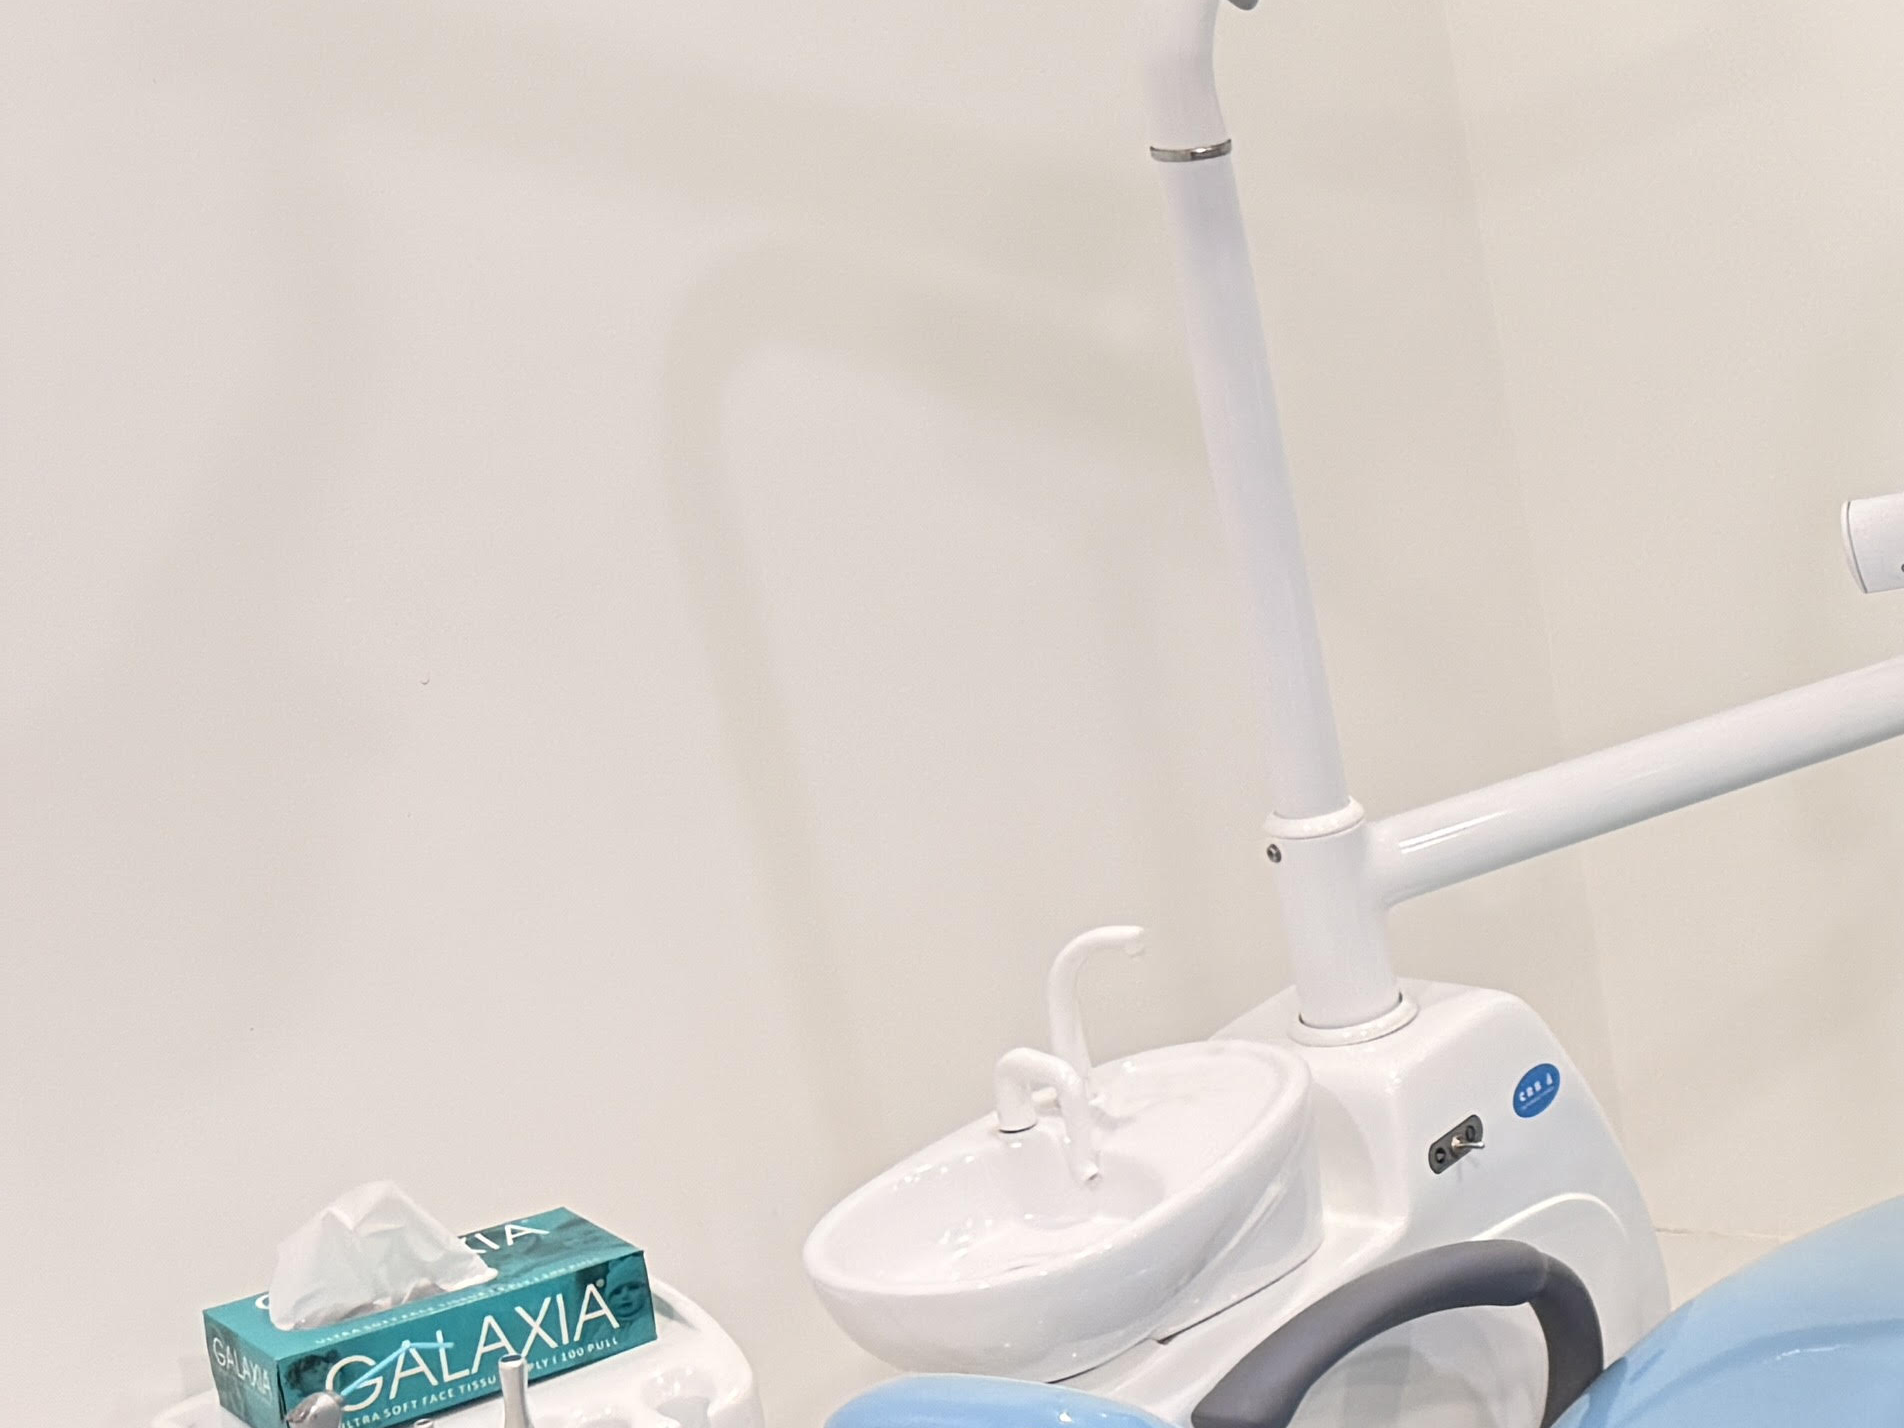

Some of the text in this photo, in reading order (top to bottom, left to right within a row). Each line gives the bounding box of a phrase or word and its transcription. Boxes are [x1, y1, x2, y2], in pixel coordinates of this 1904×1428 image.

[325, 1283, 620, 1412] GALAXIA
[384, 1400, 418, 1420] SOFT
[422, 1389, 455, 1406] FACE
[458, 1375, 497, 1396] TISSU
[560, 1347, 585, 1364] 100
[588, 1337, 619, 1355] PULL
